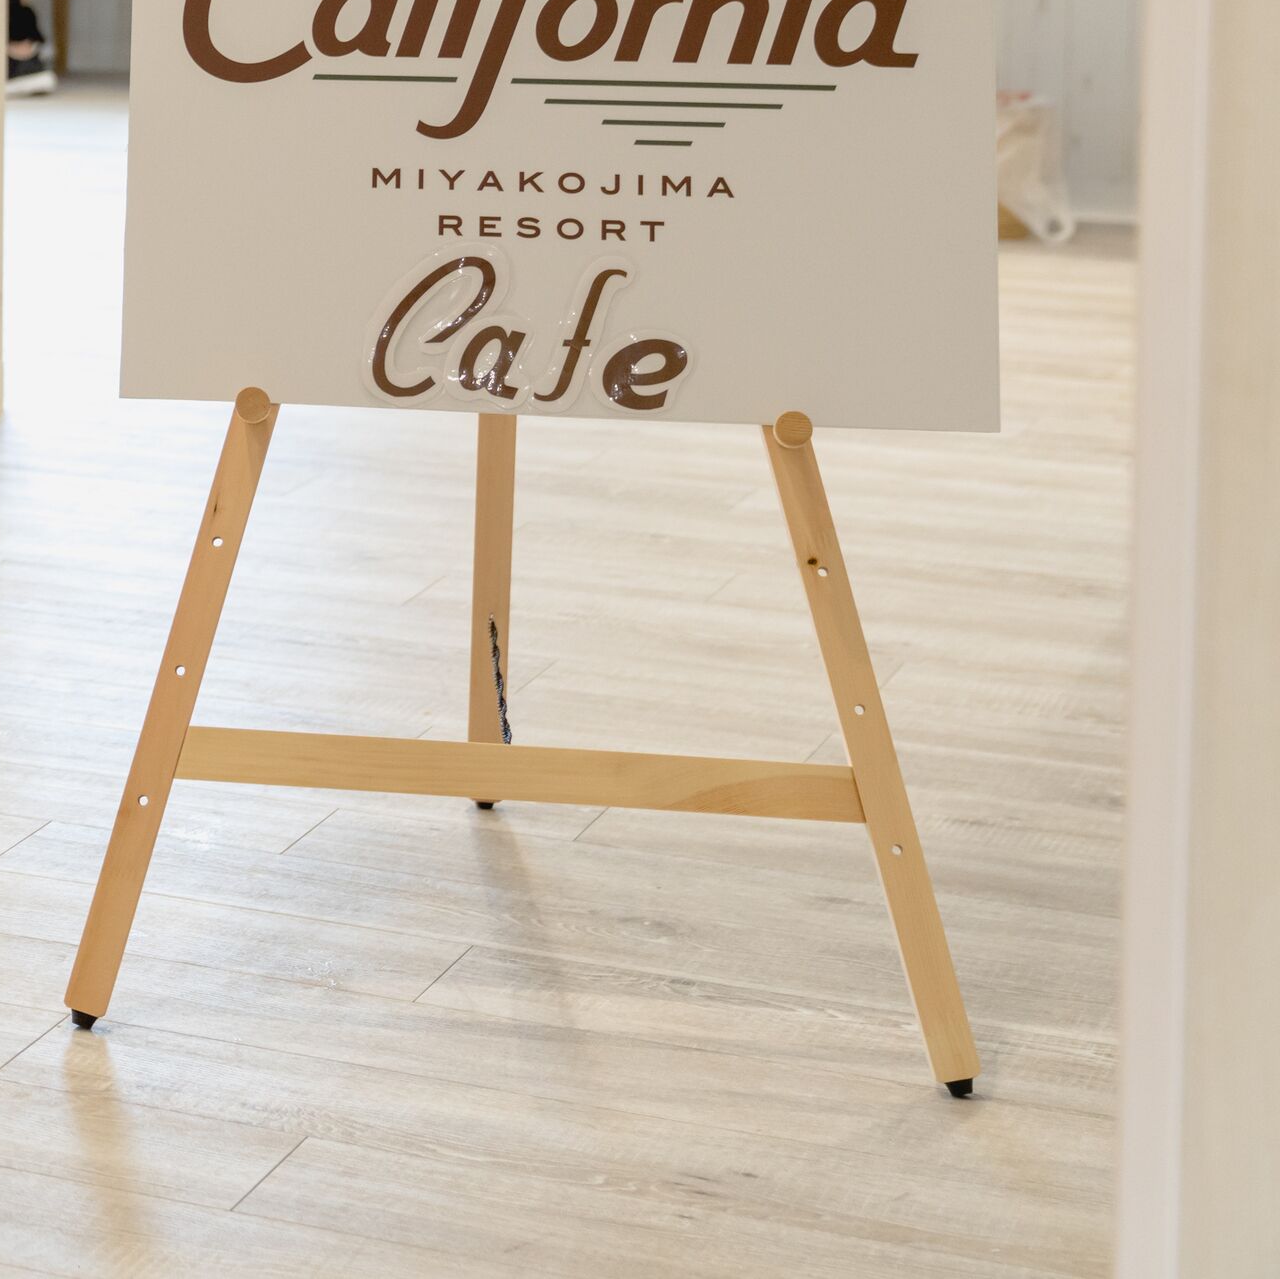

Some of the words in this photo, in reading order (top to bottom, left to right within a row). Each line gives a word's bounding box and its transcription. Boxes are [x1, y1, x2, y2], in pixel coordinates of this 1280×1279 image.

[371, 167, 735, 199] MIYAKOJIMA
[437, 214, 667, 243] RESORT
[371, 255, 689, 411] Cafe
